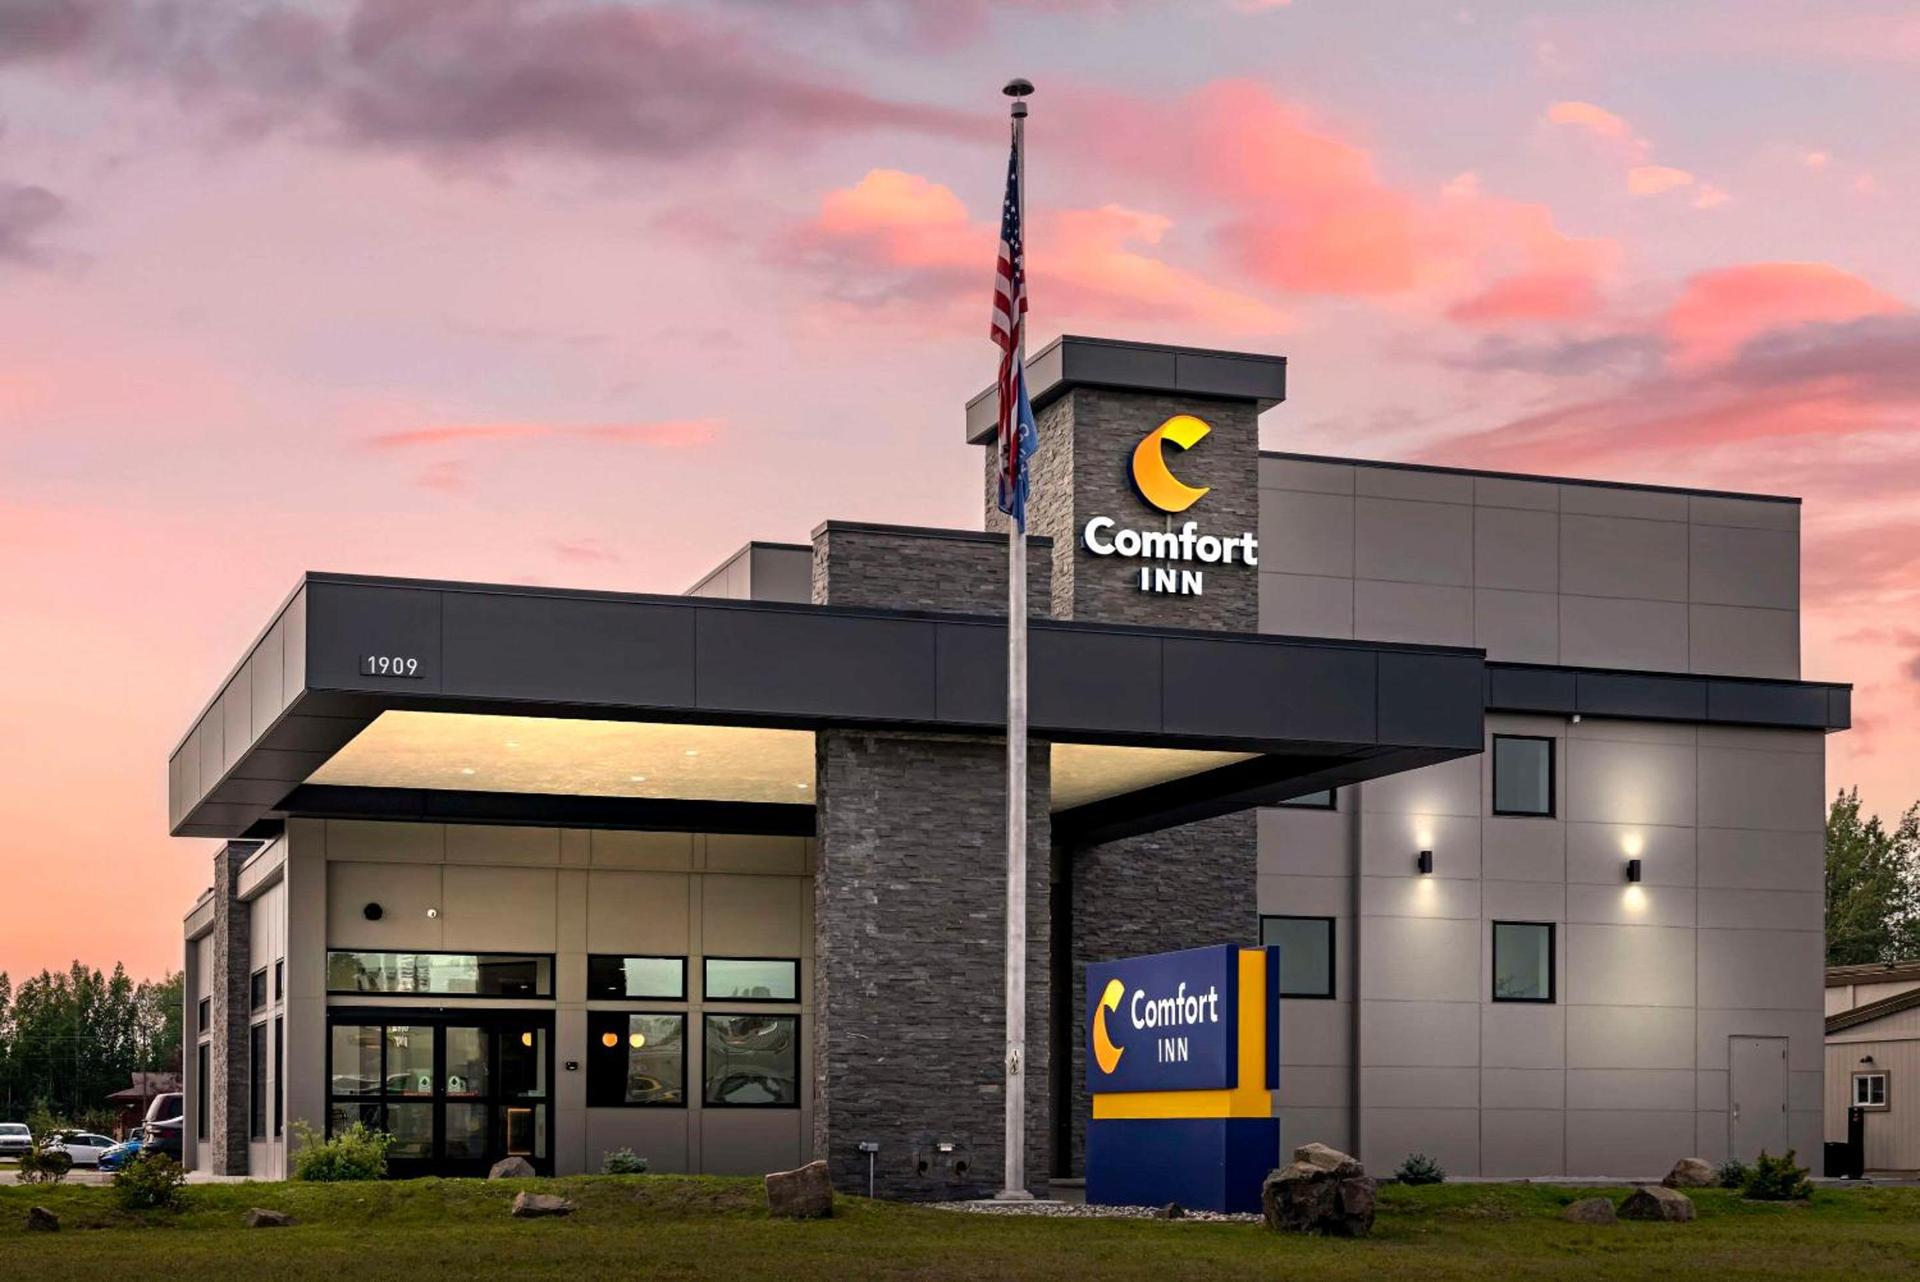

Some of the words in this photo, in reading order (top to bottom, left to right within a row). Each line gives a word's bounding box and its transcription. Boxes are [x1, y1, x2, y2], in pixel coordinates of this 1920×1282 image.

[1084, 516, 1258, 565] Comfort
[1141, 567, 1203, 595] INN
[368, 656, 418, 675] 1909
[1131, 982, 1218, 1029] Comfort
[1158, 1037, 1188, 1062] INN
